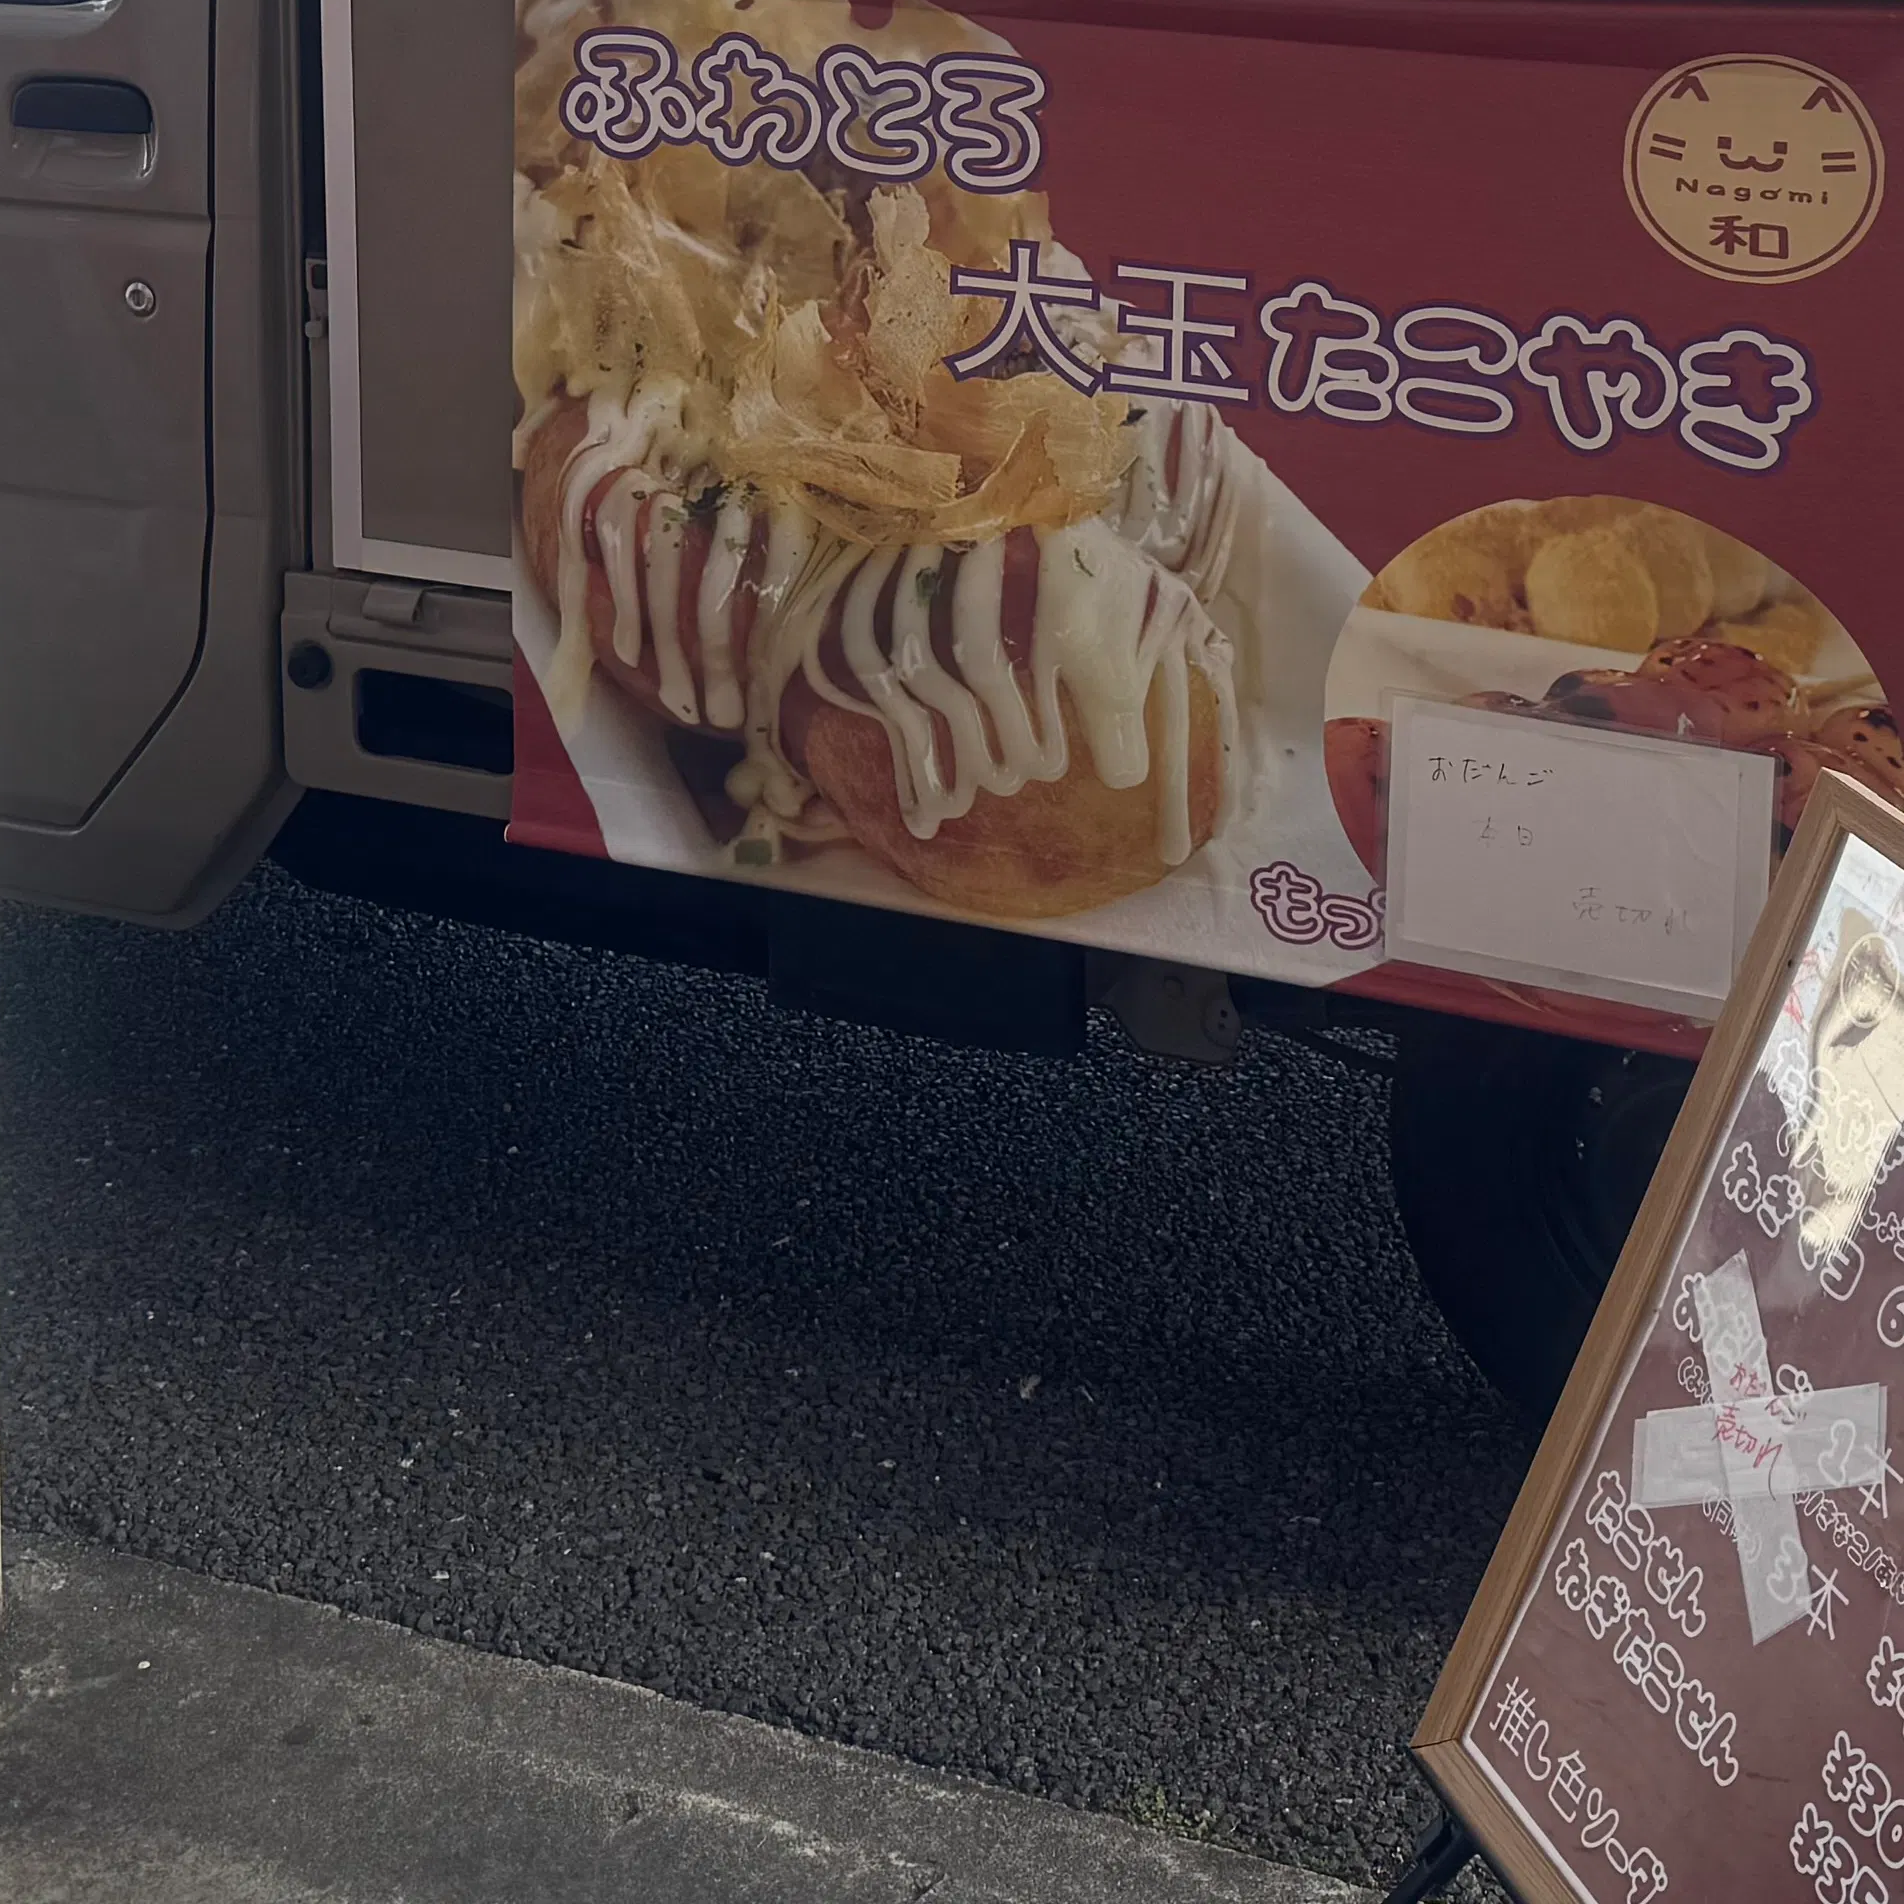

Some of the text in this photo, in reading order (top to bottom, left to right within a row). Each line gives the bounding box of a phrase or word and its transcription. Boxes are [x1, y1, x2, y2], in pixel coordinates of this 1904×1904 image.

[560, 27, 1052, 194] ふわとろ
[1675, 177, 1829, 205] Nagomi
[1709, 215, 1790, 259] 和
[946, 241, 1819, 472] 大玉たこやき
[1429, 756, 1554, 786] おだんご
[1250, 861, 1386, 950] もっ
[1572, 886, 1695, 935] 売切れ
[1723, 1141, 1864, 1301] ねぎマヨ
[1712, 1403, 1783, 1501] 売切れ
[1585, 1470, 1706, 1638] たこせん
[1555, 1538, 1739, 1787] ねぎたこせん
[1489, 1676, 1668, 1904] 推し色ソーダ
